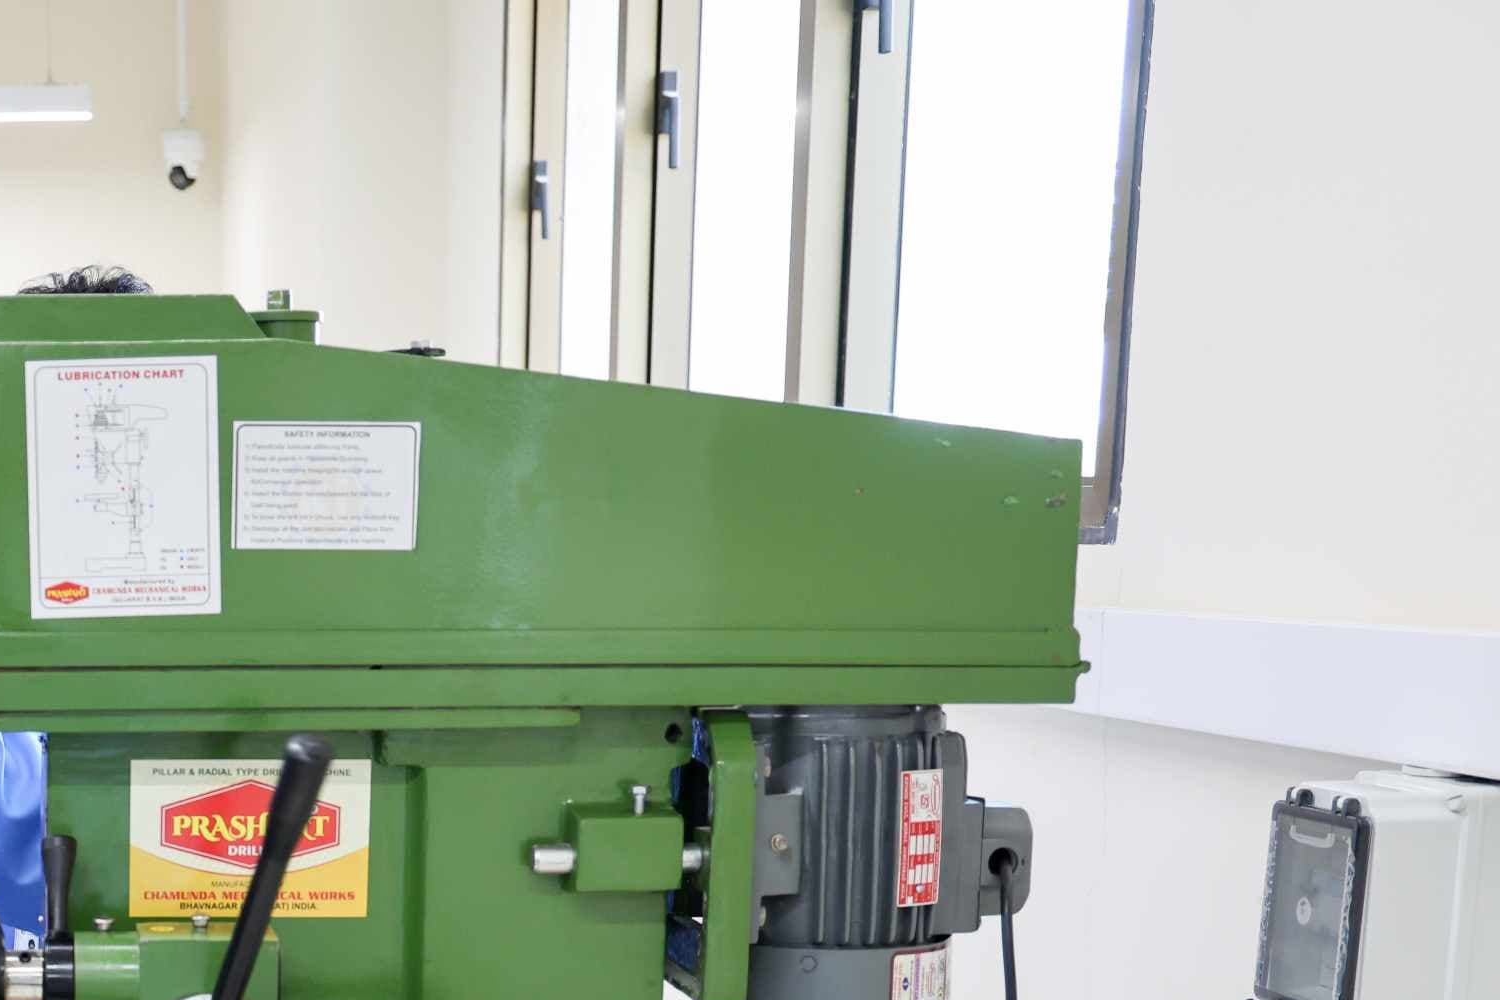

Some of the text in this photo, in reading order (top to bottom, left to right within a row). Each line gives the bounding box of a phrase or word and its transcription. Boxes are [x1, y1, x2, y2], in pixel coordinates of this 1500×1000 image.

[57, 369, 184, 381] LUBRICATION CHART
[152, 768, 186, 776] PILLAR
[188, 768, 195, 776] &
[198, 768, 232, 776] RADIAL
[236, 768, 259, 776] TYPE
[172, 812, 329, 841] PRASHT
[143, 891, 356, 901] CHAMUNDA MECICAL WORKS
[180, 902, 238, 910] BHAVNAGAR
